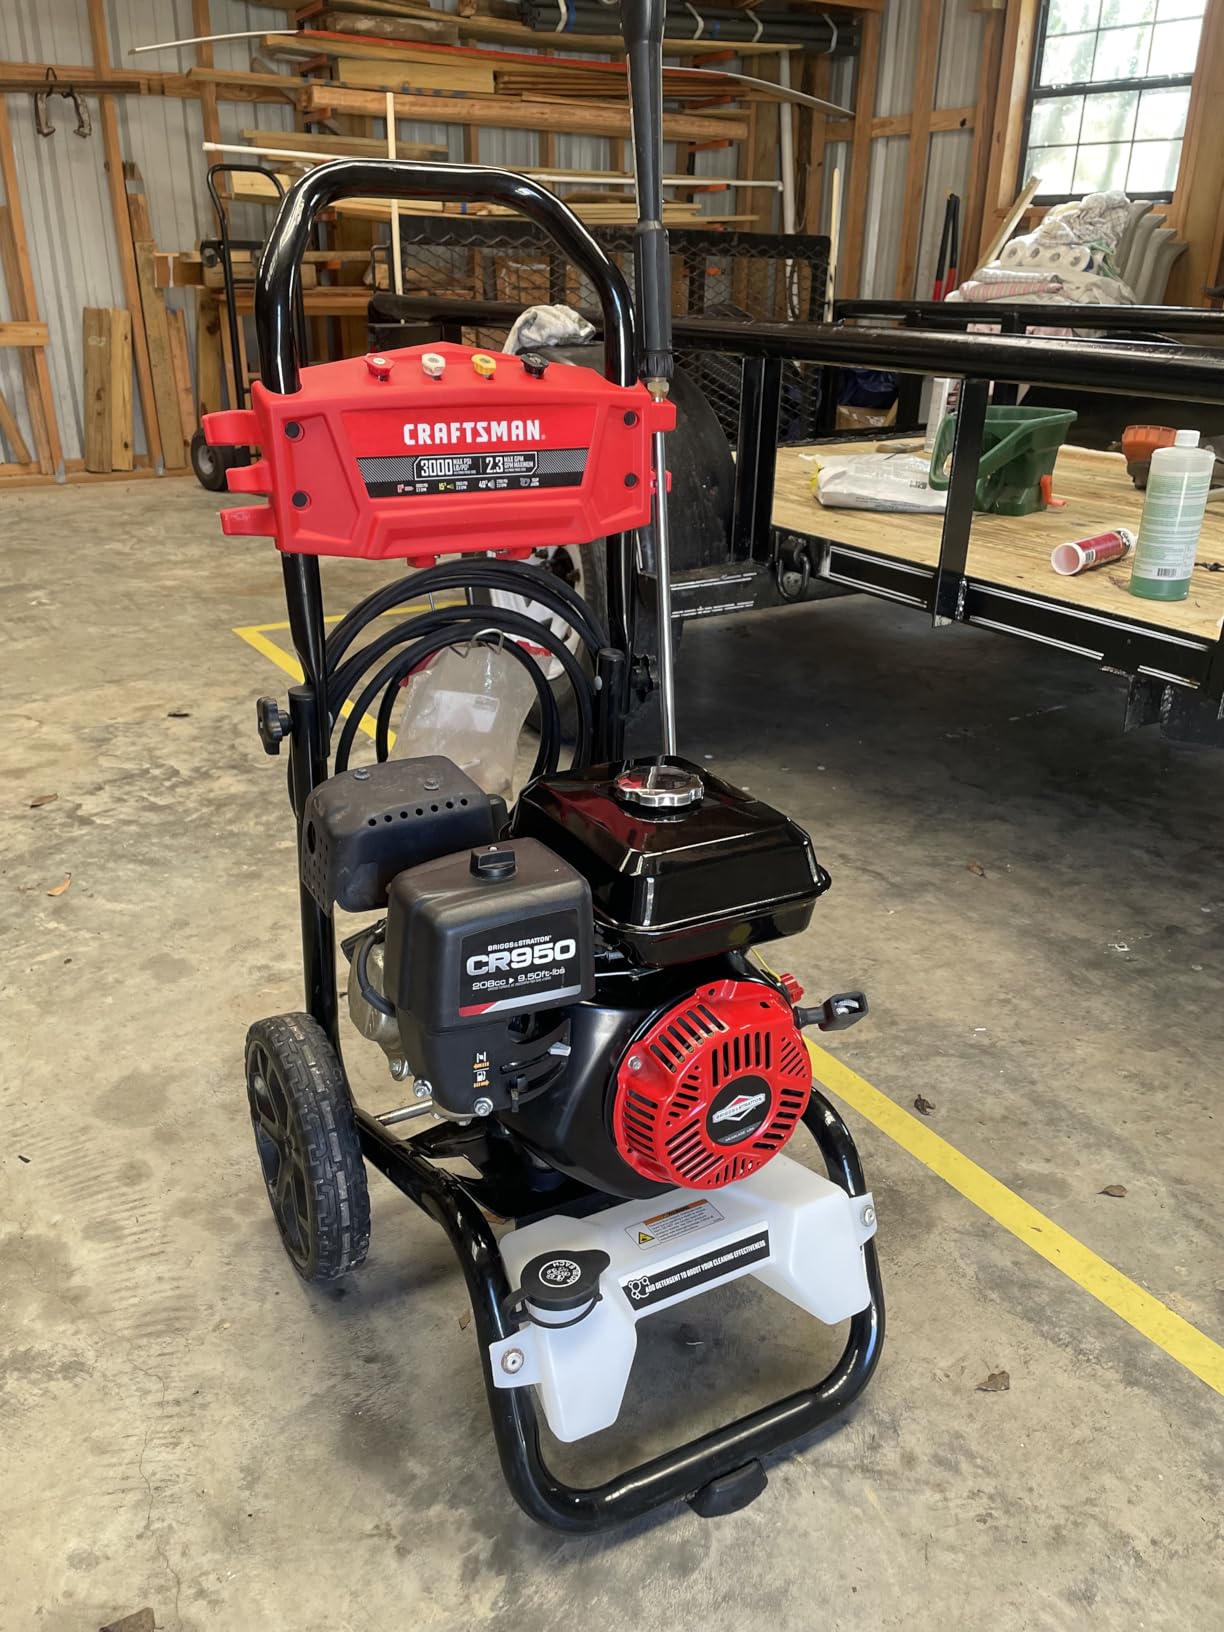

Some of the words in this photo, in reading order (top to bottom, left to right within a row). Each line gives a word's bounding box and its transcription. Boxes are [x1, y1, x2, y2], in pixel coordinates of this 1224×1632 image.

[403, 419, 540, 445] CRAFTSMAN
[420, 459, 453, 476] 3000
[486, 456, 503, 473] 2.3
[466, 939, 576, 976] CR950
[472, 979, 507, 991] 208cc
